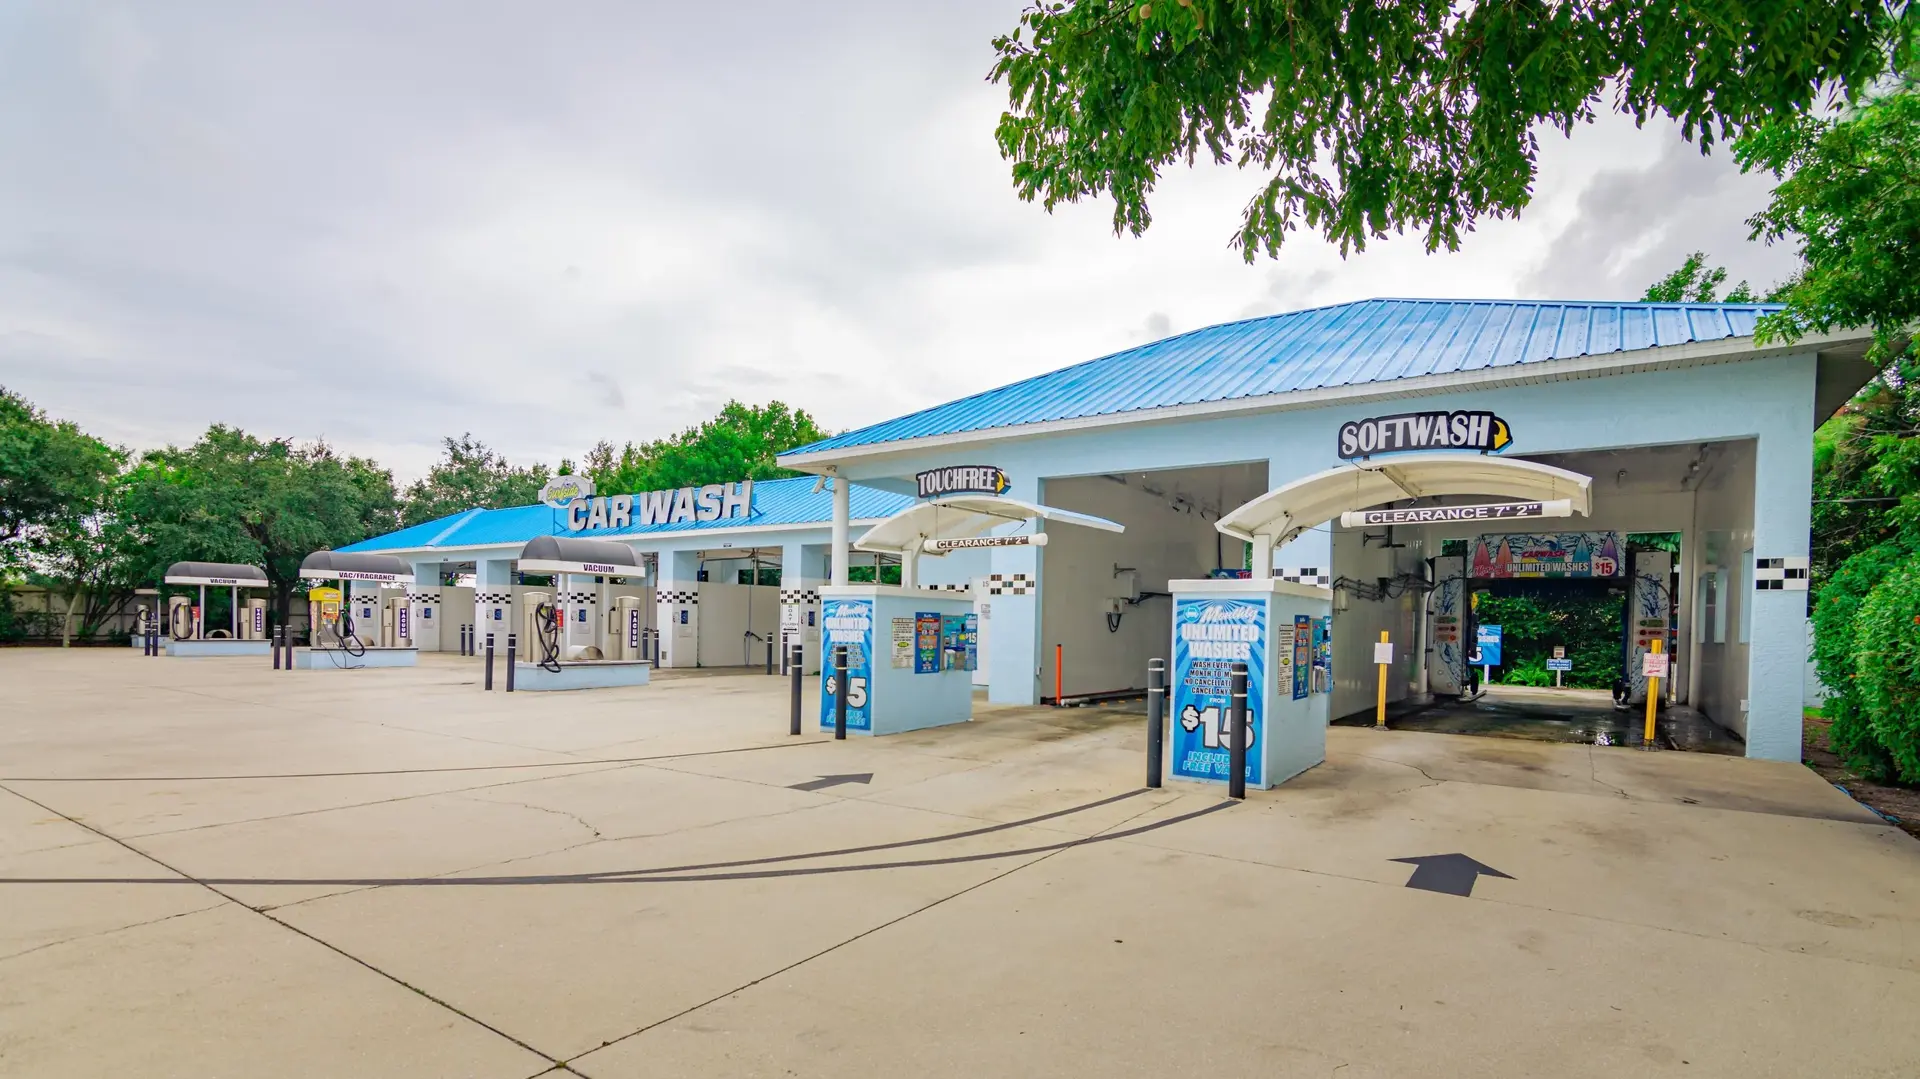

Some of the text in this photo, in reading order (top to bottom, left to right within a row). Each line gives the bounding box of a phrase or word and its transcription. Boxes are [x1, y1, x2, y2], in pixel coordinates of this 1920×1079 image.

[1342, 415, 1491, 455] SOFTWASH
[918, 468, 996, 495] TOUCHFREE
[567, 481, 754, 532] CAR WASH
[1368, 505, 1538, 523] CLEARANCE 7' 2"
[938, 538, 1001, 548] CLEARANCE
[583, 563, 615, 573] VACUUM
[1507, 563, 1550, 572] UNLIMITED
[1552, 562, 1589, 572] WASHES
[1595, 562, 1613, 575] $15
[338, 572, 396, 581] VAC/FRAGRANCE
[1200, 605, 1258, 623] Monthly
[1182, 624, 1258, 641] UNLIMITED
[1189, 642, 1250, 659] WASHES
[1213, 661, 1231, 669] EVERY
[1190, 669, 1212, 677] MONTH
[825, 675, 867, 708] $5
[1183, 760, 1211, 772] FREE
